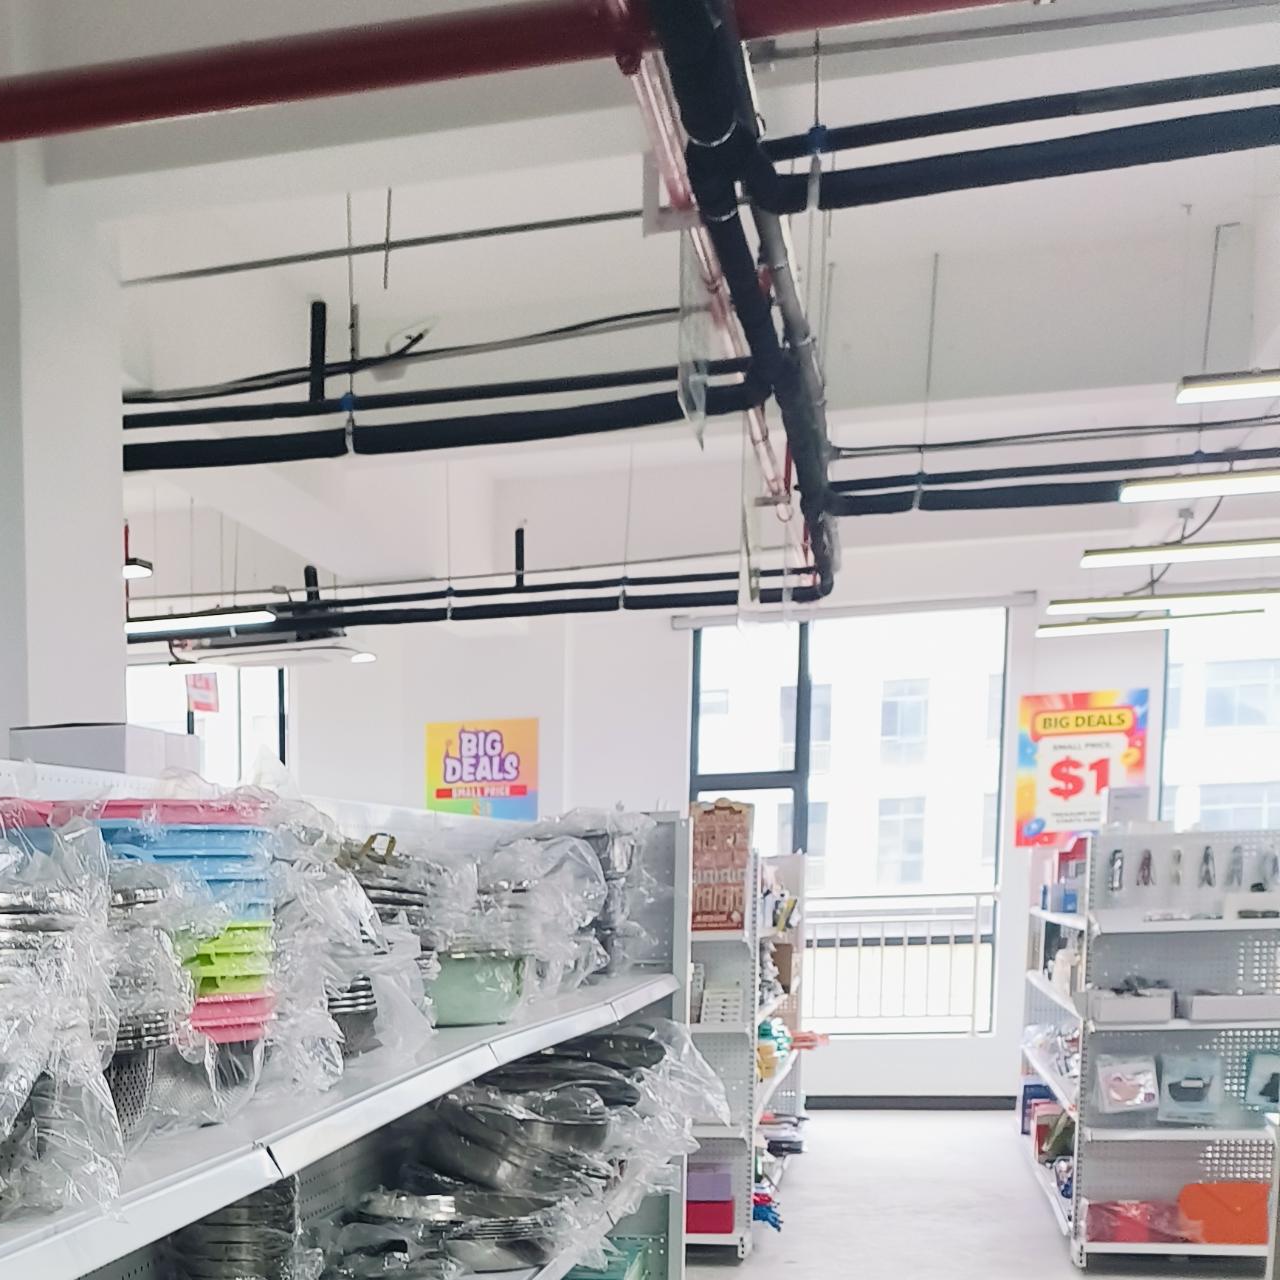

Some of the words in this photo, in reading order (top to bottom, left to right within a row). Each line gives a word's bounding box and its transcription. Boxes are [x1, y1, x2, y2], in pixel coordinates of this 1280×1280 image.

[1042, 716, 1070, 730] BIG
[1074, 712, 1126, 728] DEALS
[459, 729, 504, 758] BIG
[443, 752, 520, 784] DEALS
[1049, 755, 1110, 801] $1
